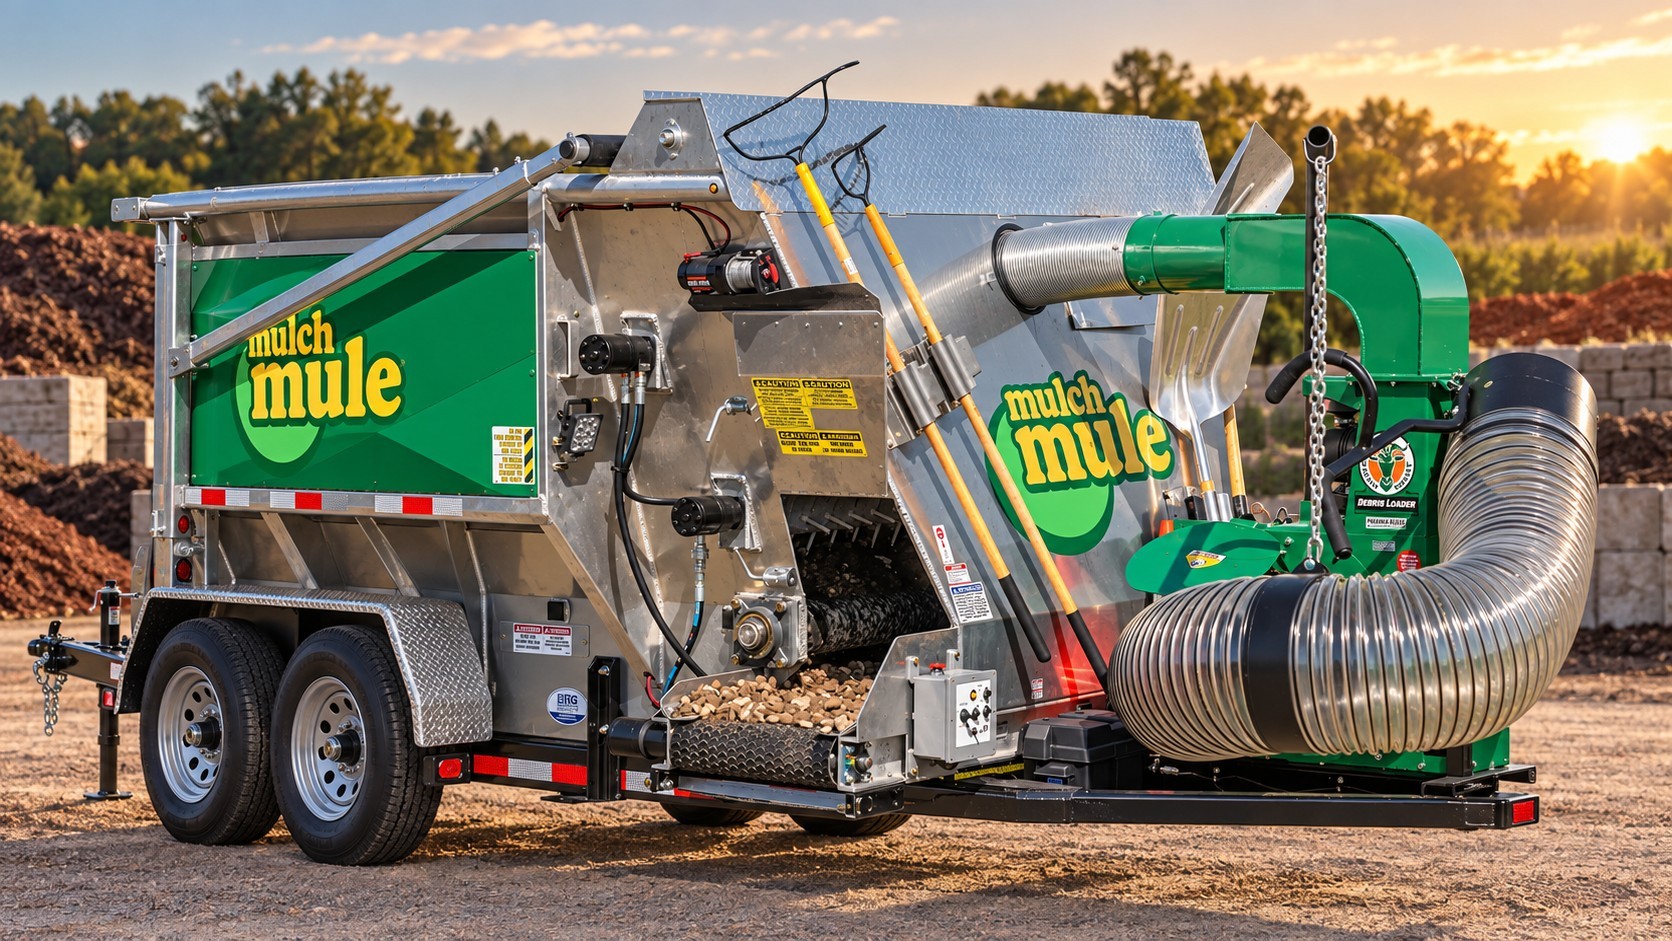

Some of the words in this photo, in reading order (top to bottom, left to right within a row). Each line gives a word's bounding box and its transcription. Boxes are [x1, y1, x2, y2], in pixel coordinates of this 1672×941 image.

[248, 310, 335, 357] mulch
[251, 336, 402, 419] mule
[1004, 375, 1106, 421] mulch
[1014, 398, 1171, 485] mule
